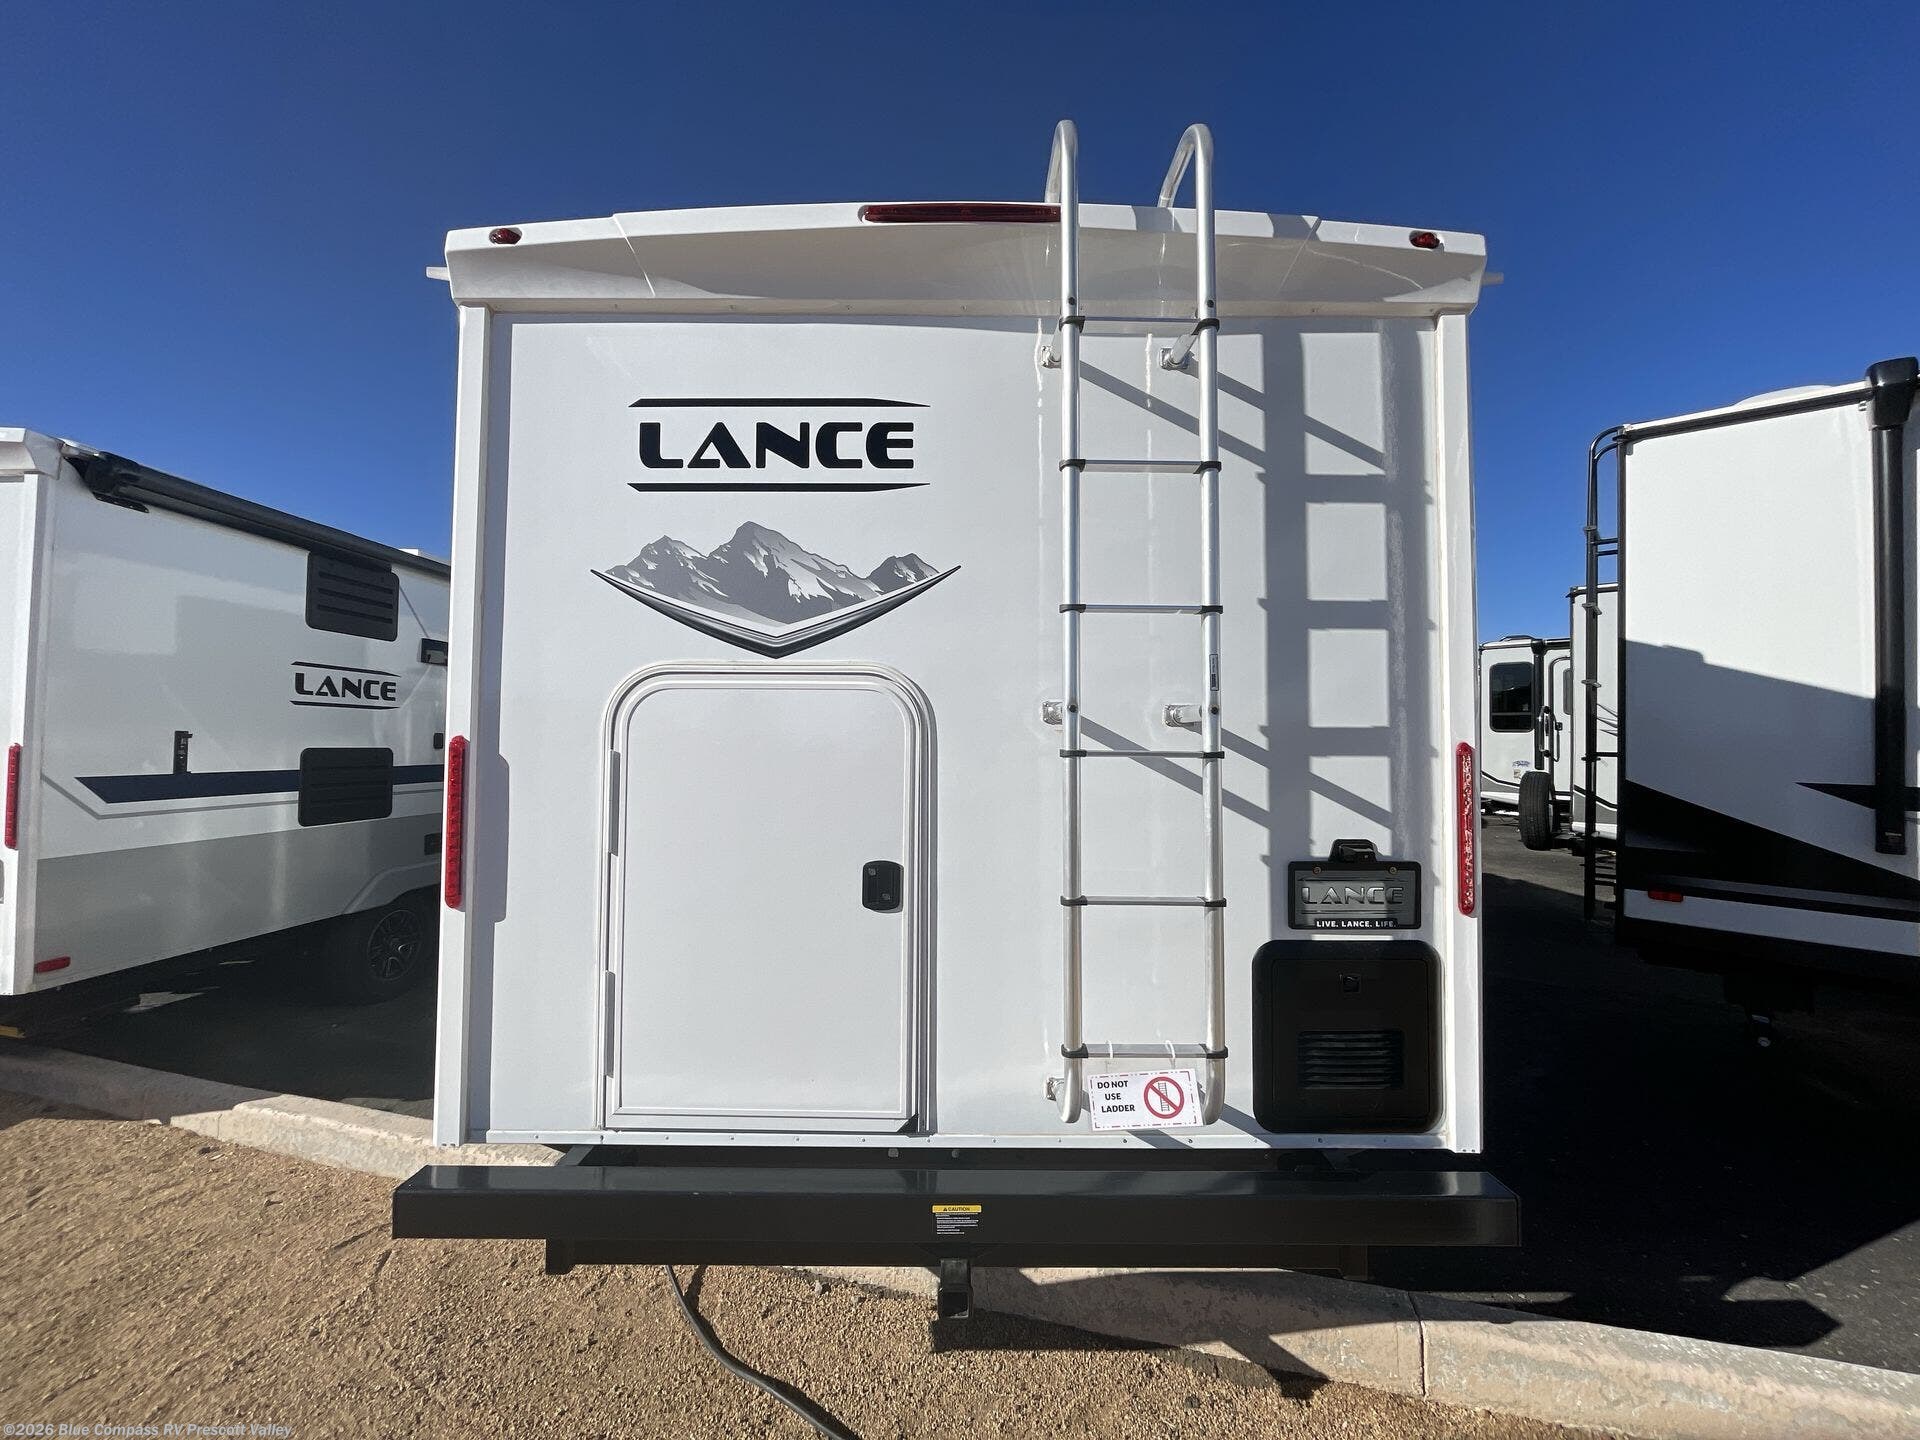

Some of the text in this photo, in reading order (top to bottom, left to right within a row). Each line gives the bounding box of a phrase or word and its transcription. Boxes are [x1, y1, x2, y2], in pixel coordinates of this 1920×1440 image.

[639, 421, 914, 469] LANCE
[295, 672, 396, 701] LANCE
[1302, 886, 1403, 905] LANCE
[1097, 1080, 1128, 1089] DO NOT
[1101, 1104, 1135, 1113] LADDER
